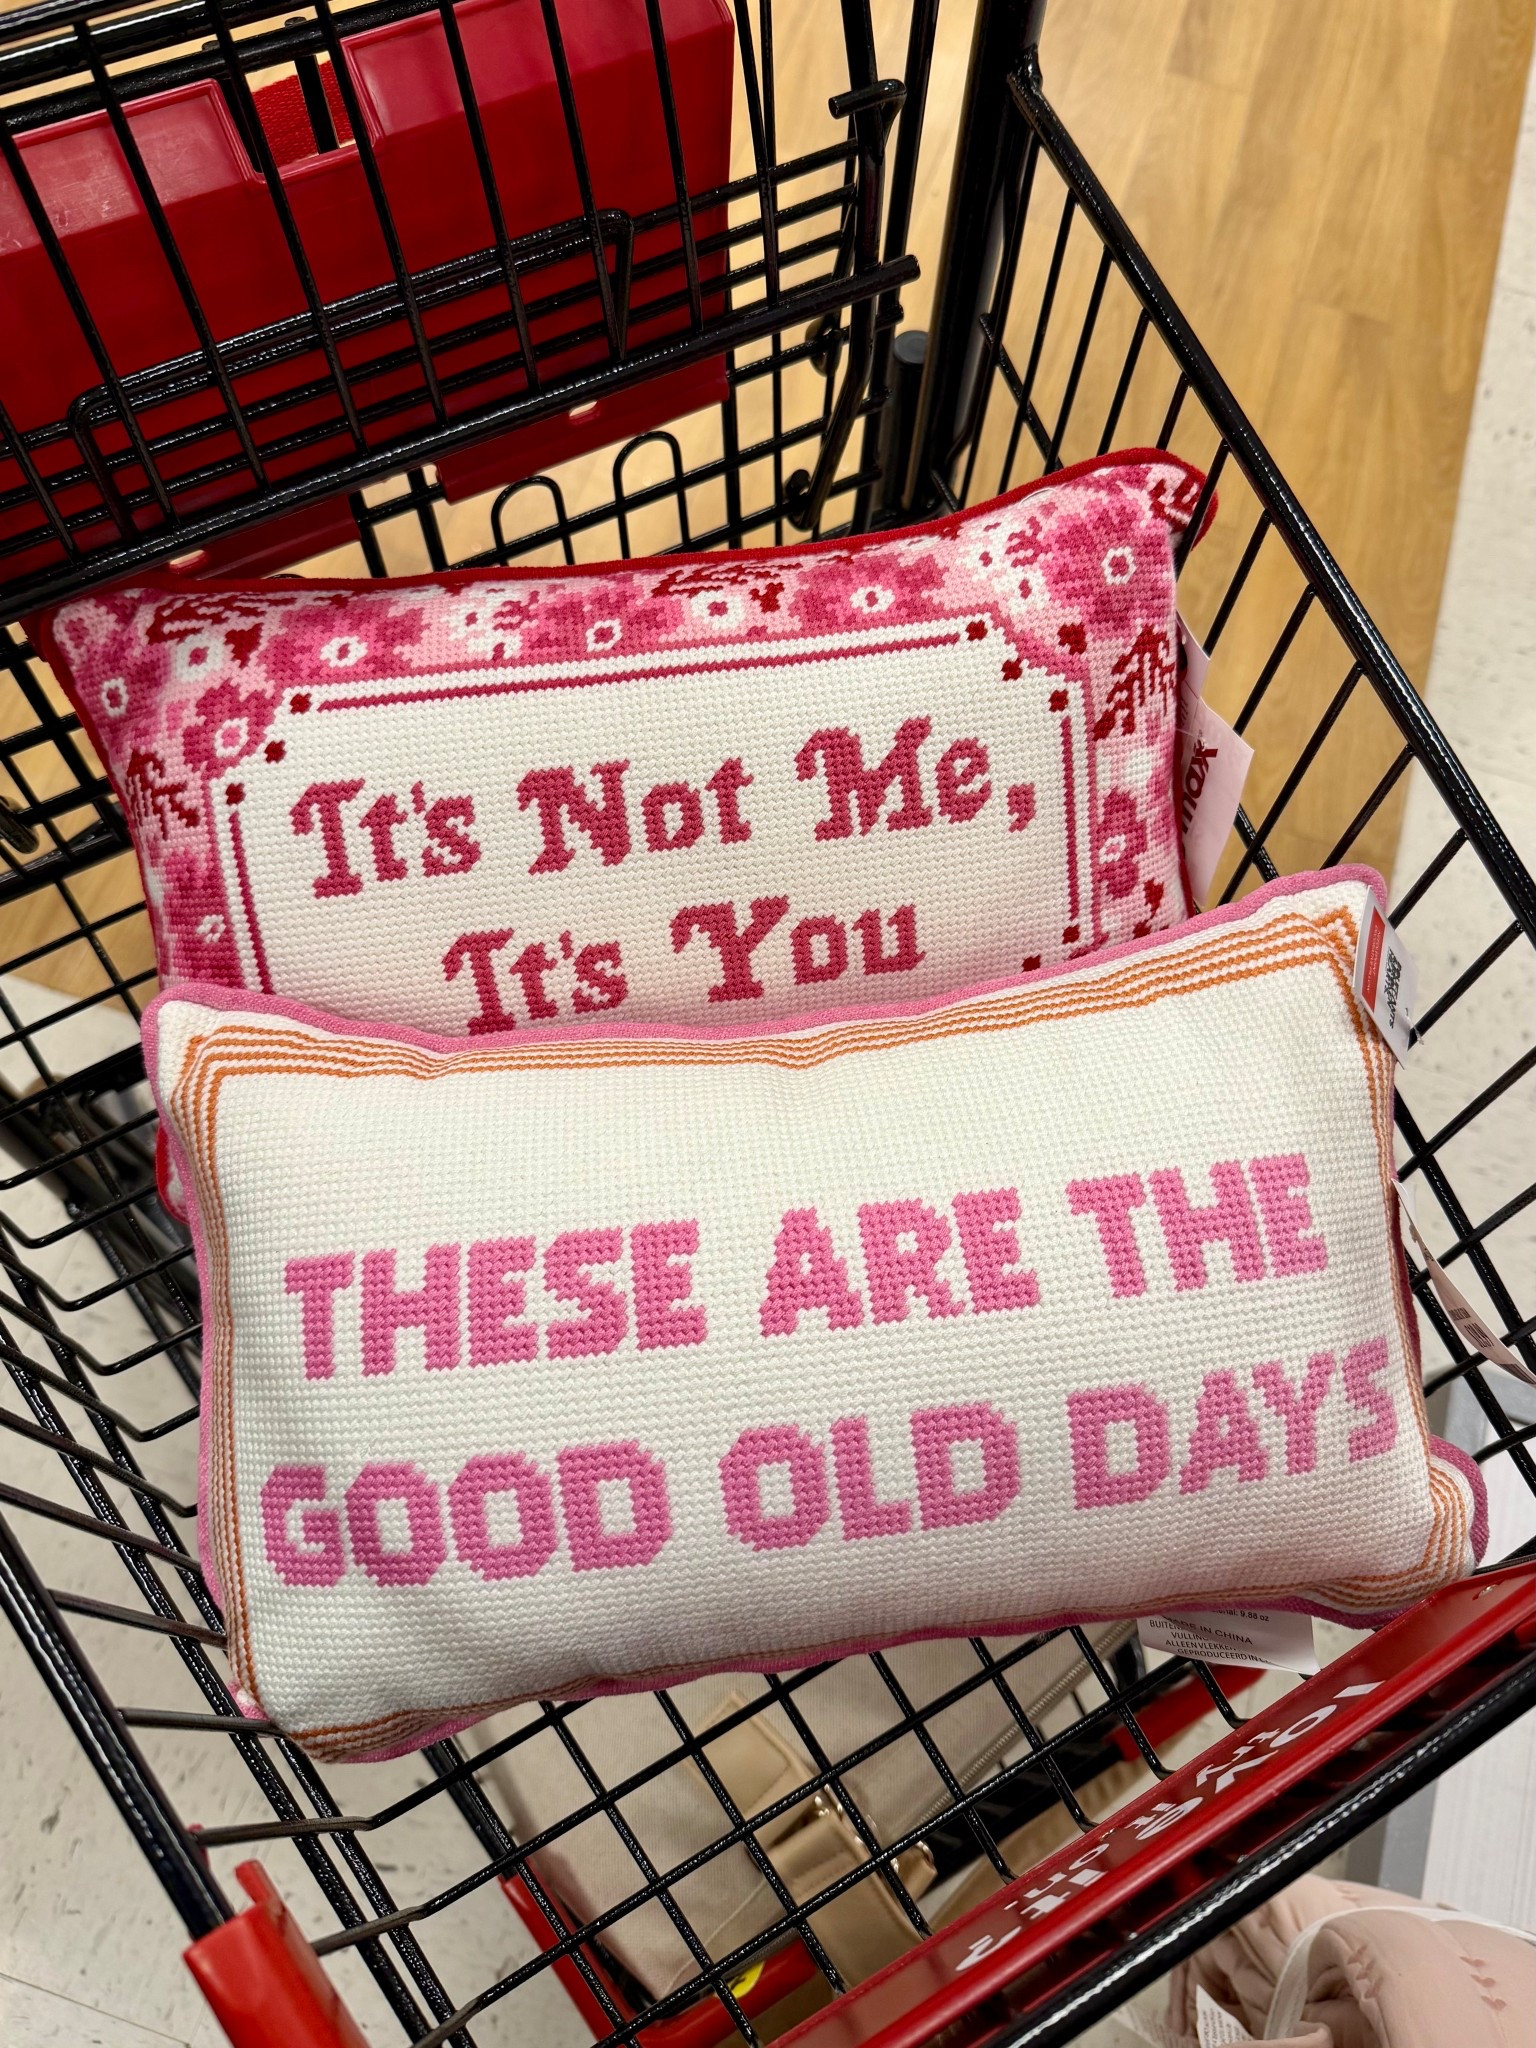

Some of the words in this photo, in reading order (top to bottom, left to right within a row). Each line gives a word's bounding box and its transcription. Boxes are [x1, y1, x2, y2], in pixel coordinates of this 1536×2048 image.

[289, 778, 481, 899] It's
[516, 757, 753, 876] Not
[794, 715, 1035, 842] Me,
[441, 928, 628, 1037] It's
[669, 895, 926, 1003] You
[284, 1217, 707, 1381] THESE
[759, 1187, 1040, 1338] ARE
[1066, 1153, 1327, 1299] THE
[260, 1439, 672, 1587] GOOD
[719, 1403, 1020, 1552] OLD
[1066, 1337, 1398, 1510] DAYS
[1165, 1639, 1198, 1649] ALLEEN
[1200, 1625, 1212, 1633] IN
[1214, 1629, 1254, 1645] CHINA
[1240, 1609, 1258, 1620] 9.88
[1178, 1648, 1247, 1660] GEPRODUCEERD
[1136, 1680, 1385, 1840] love
[1196, 1728, 1281, 1788] try
[1123, 1802, 1178, 1830] it
[1004, 1843, 1109, 1910] on.
[955, 1868, 1108, 1972] it?
